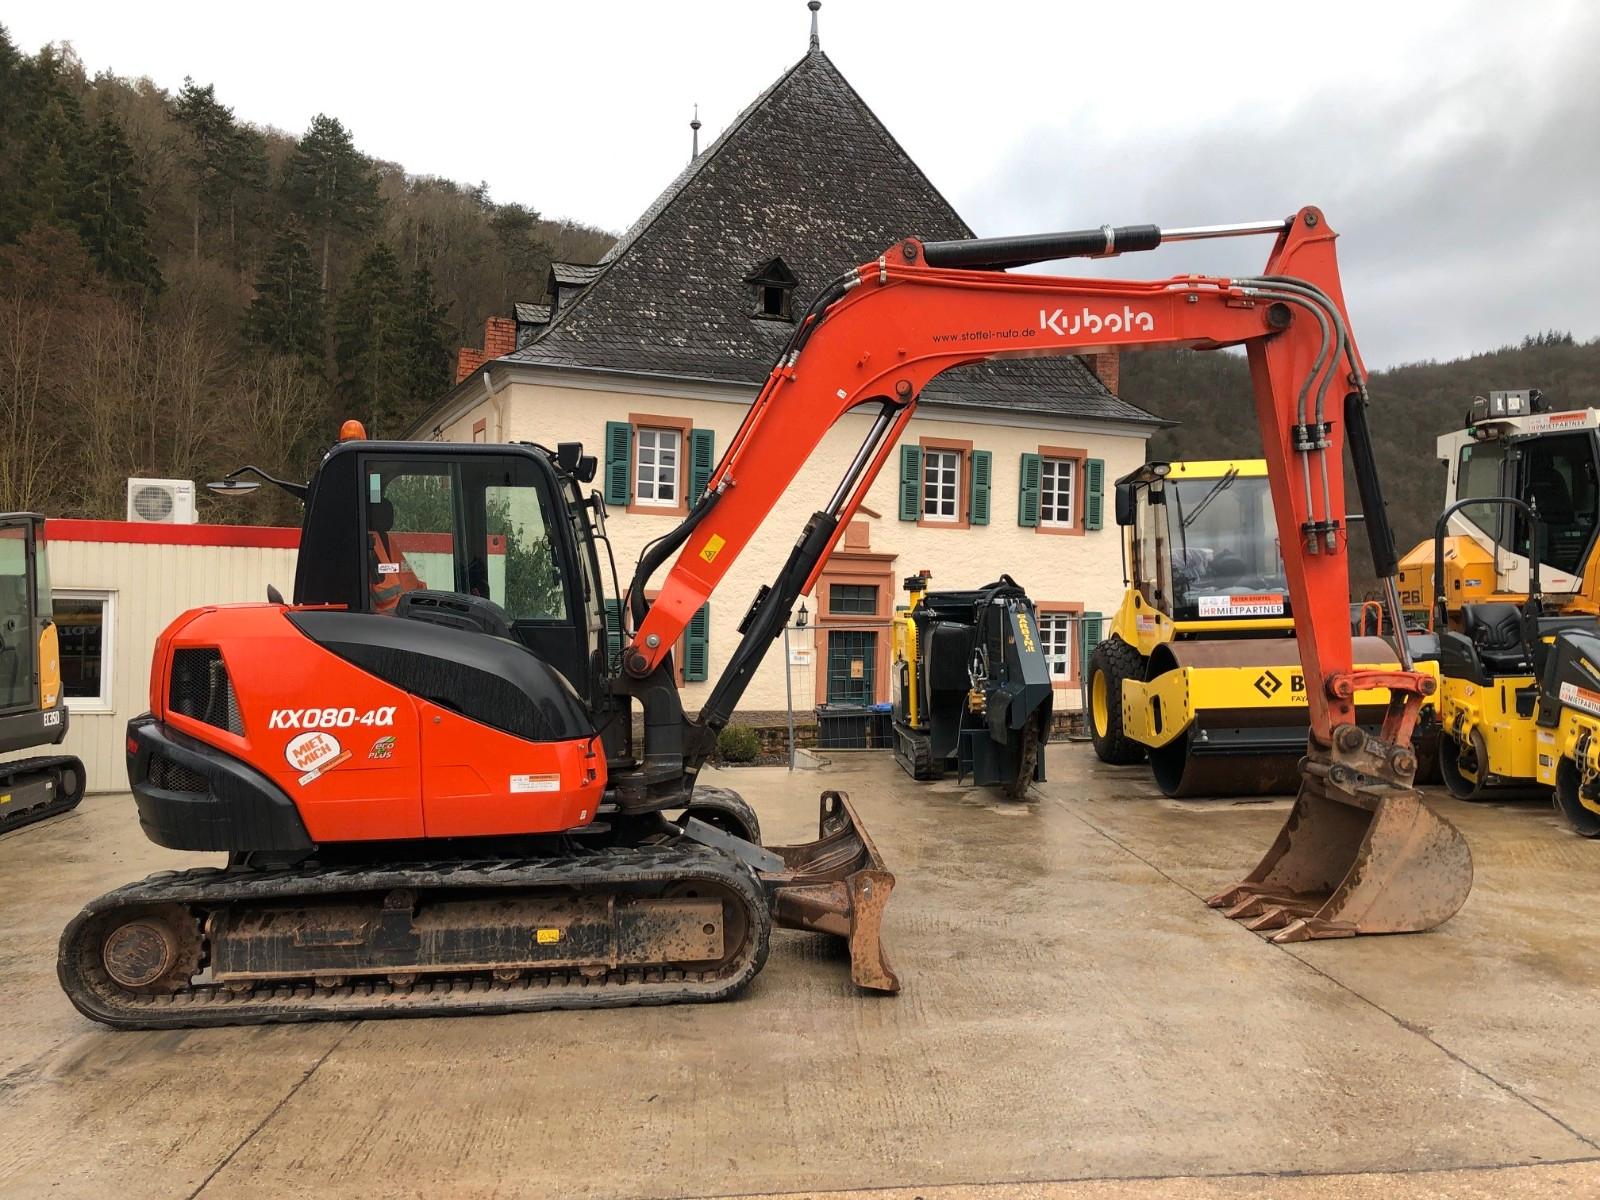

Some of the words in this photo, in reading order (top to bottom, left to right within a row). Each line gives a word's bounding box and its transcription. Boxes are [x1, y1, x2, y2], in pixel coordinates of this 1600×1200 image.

[1039, 305, 1154, 336] Kubota
[1397, 590, 1420, 604] 26
[1200, 605, 1282, 616] IHRMIETPARTNER
[291, 734, 325, 759] MIET
[296, 743, 332, 769] MICH
[368, 751, 393, 759] PLUS
